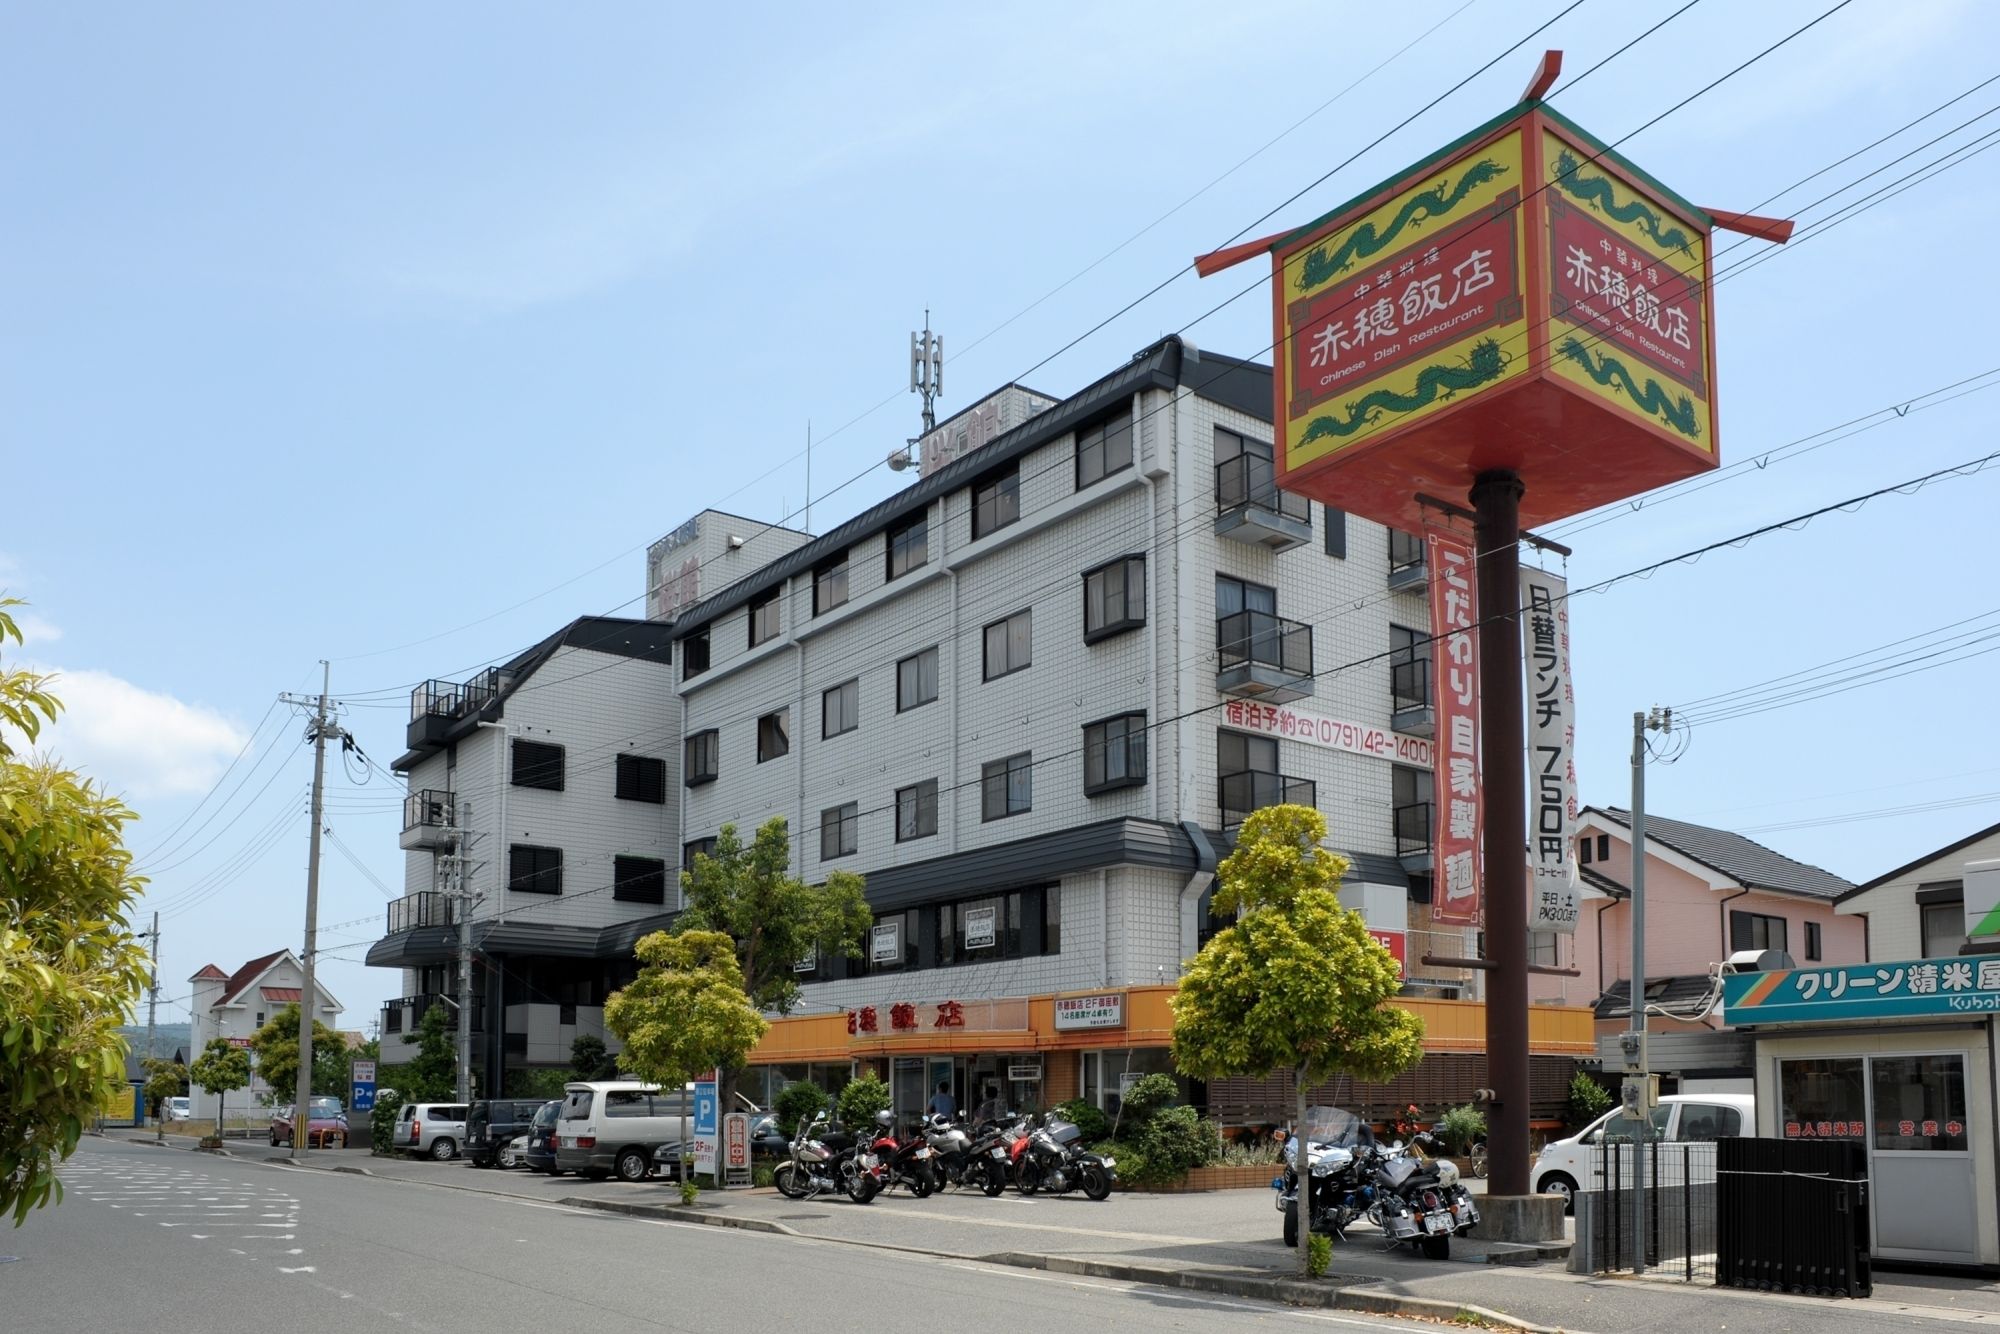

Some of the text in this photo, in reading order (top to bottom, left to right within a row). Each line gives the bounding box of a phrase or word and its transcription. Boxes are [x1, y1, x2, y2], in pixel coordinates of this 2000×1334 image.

[1310, 249, 1495, 368] 赤穂飯店
[1566, 244, 1691, 350] 赤穂飯店
[1320, 305, 1485, 386] Chinese Dish Restaurant
[1639, 335, 1686, 369] Restaurant
[1796, 960, 2000, 1001] クリーン精米屋
[354, 1087, 365, 1100] P
[700, 1099, 711, 1121] P
